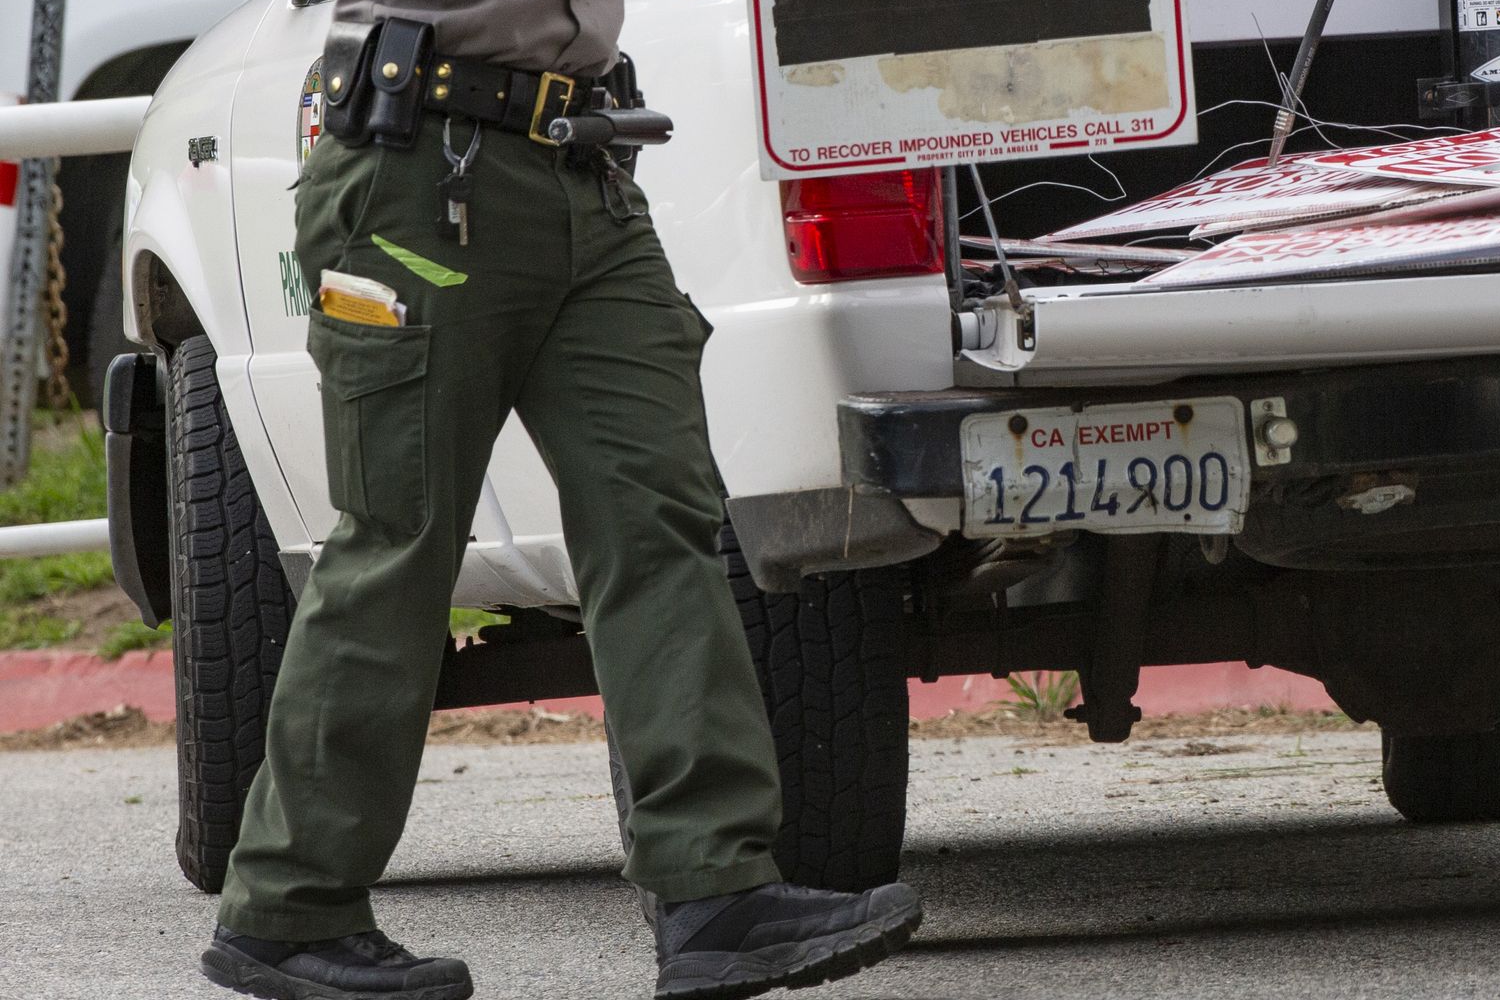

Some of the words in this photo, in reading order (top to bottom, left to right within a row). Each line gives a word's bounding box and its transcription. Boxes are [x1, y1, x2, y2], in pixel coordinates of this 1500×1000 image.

[789, 149, 810, 162] TO
[818, 141, 893, 160] RECOVER
[899, 132, 994, 153] IMPOUNDED
[1000, 124, 1078, 144] VEHICLES
[1085, 120, 1125, 137] CALL
[1131, 117, 1155, 133] 311
[917, 152, 953, 162] PROPERTY
[958, 150, 974, 159] CITY
[979, 148, 986, 157] OF
[990, 146, 1003, 155] LOS
[1006, 144, 1039, 154] ANGELES
[278, 251, 313, 317] PAR
[1031, 428, 1065, 448] CA
[1078, 421, 1176, 445] EXEMPT
